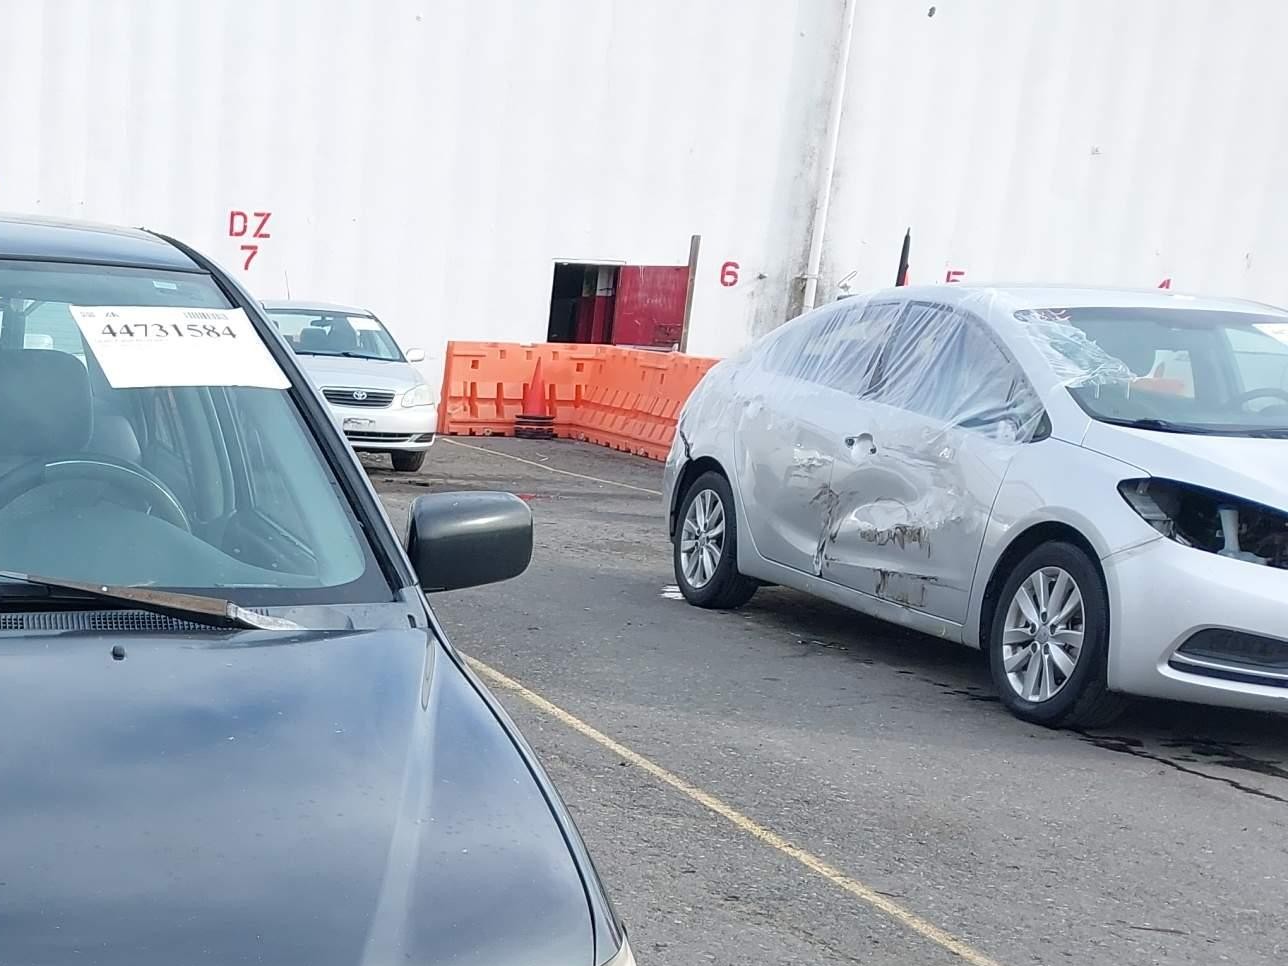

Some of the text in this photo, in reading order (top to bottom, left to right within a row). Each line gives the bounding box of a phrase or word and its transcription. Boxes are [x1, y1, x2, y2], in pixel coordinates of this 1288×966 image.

[229, 211, 272, 238] DZ
[240, 245, 258, 271] 7
[720, 261, 740, 287] 6
[100, 323, 237, 339] 44731584
